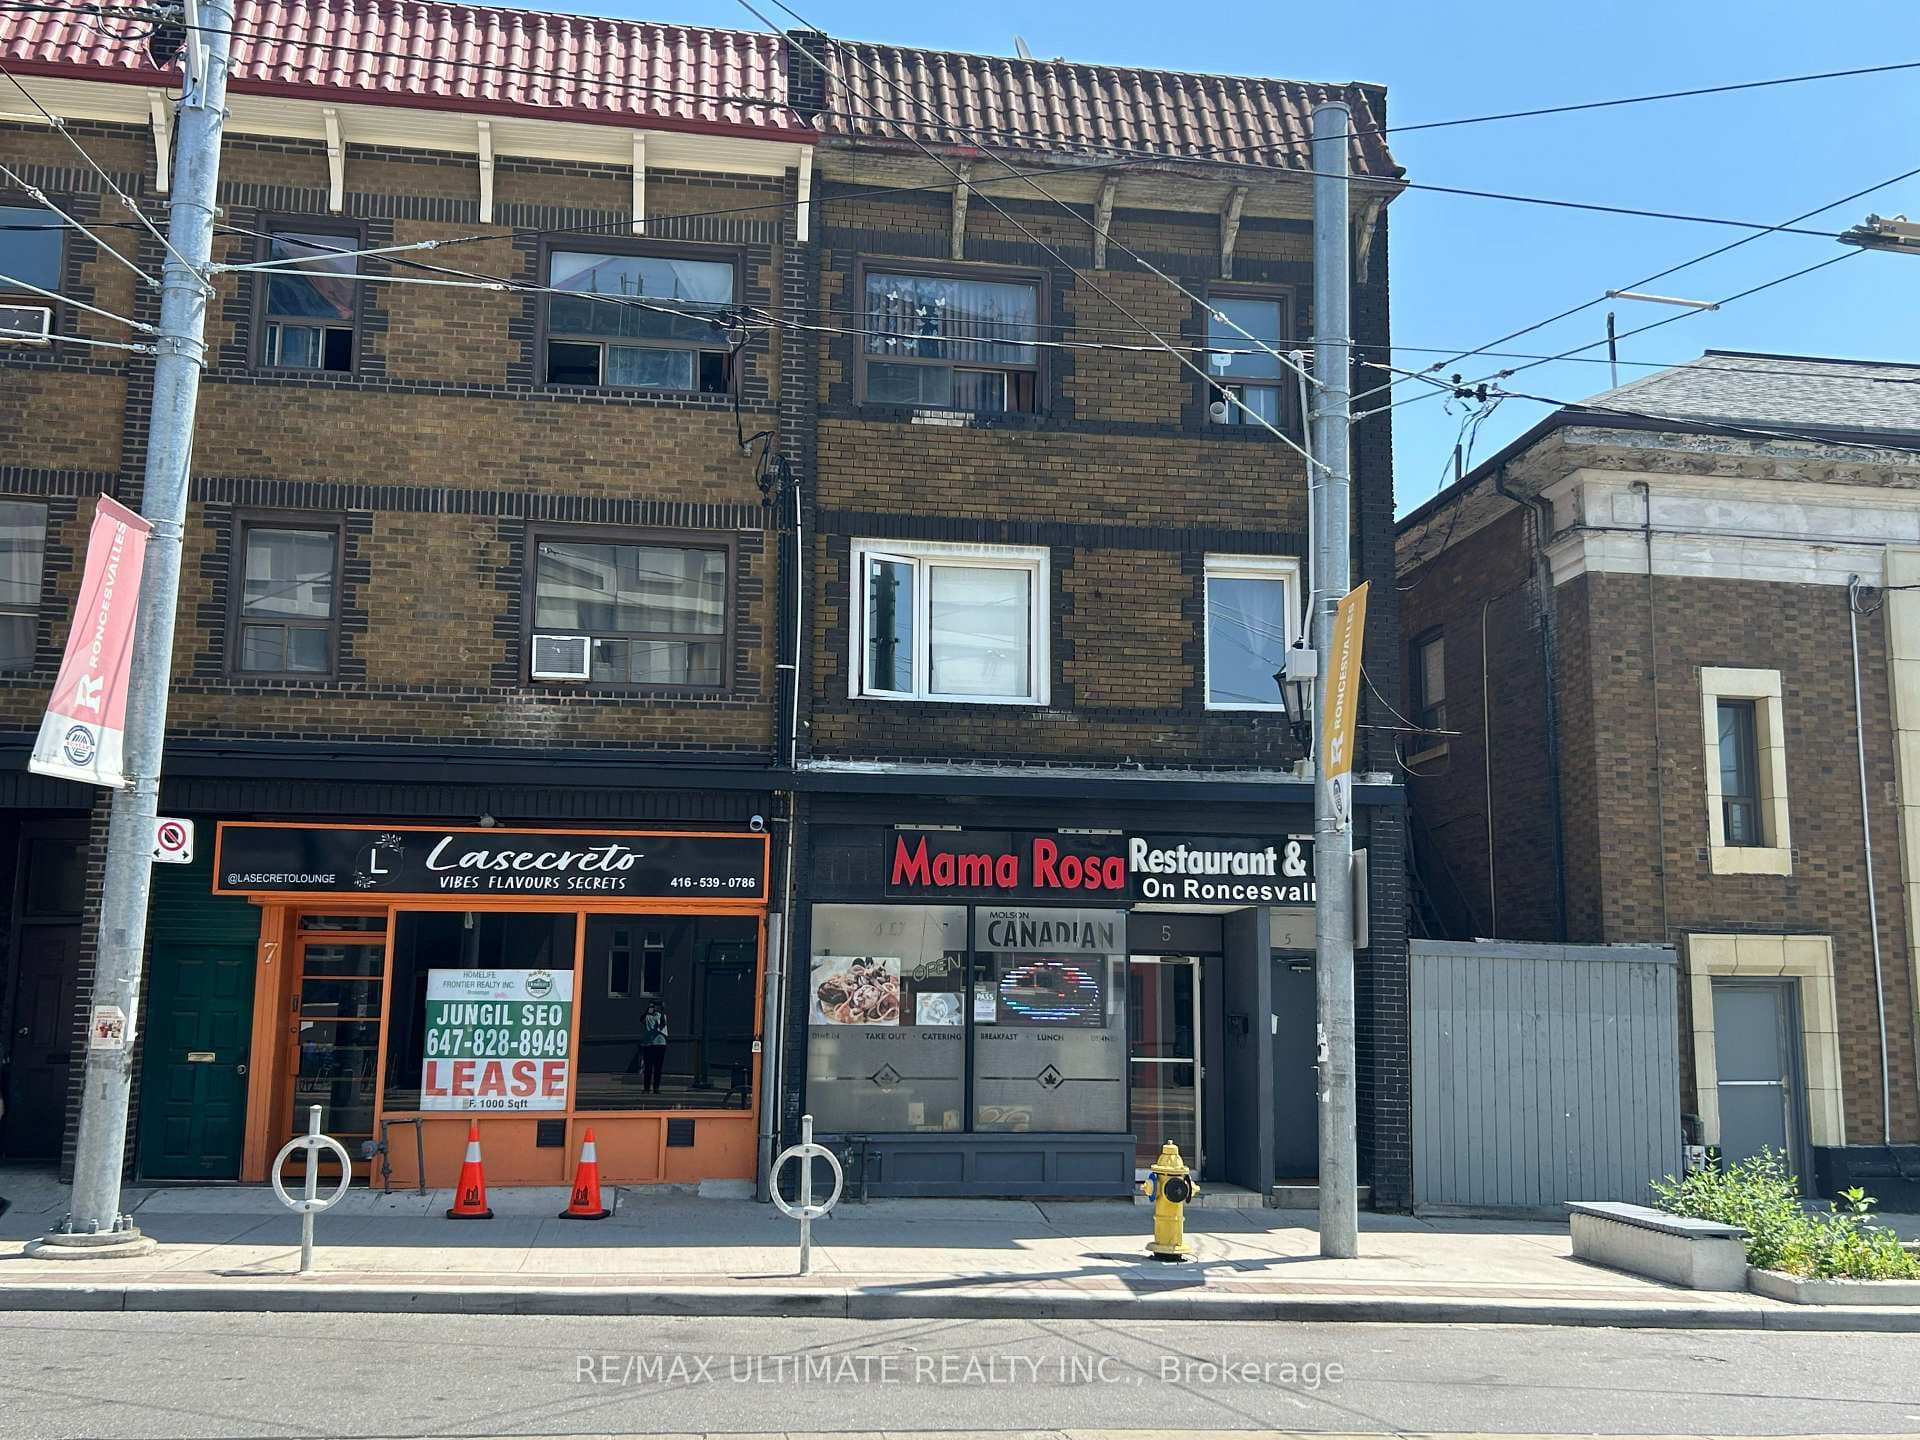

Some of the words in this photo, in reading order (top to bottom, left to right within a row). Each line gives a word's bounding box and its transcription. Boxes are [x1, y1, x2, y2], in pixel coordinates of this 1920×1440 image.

[89, 521, 128, 669] RONCESVALLES
[1335, 602, 1355, 729] RONCESVALLES
[371, 848, 388, 874] L
[425, 836, 645, 872] Lasecreto
[890, 833, 1019, 888] Mama
[1032, 837, 1125, 890] Rosa
[1128, 837, 1277, 876] Restaurant
[1282, 840, 1307, 877] &
[227, 873, 336, 884] @LASECRETOLOUNGE
[439, 875, 480, 889] VIBES
[488, 875, 561, 889] FLAVOURS
[567, 876, 628, 890] SECRETS
[1142, 878, 1175, 898] On
[1183, 879, 1316, 901] Roncesvall
[989, 911, 1030, 919] MOLSON
[987, 920, 1114, 949] CANADIAN
[1161, 925, 1172, 942] 5
[1284, 933, 1292, 945] 5
[263, 942, 280, 964] 7
[912, 951, 961, 982] OPEN
[443, 981, 475, 989] FRONTIER
[476, 981, 501, 989] REALTY
[976, 991, 994, 1000] PASS
[436, 1004, 513, 1026] JUNGIL
[521, 1004, 563, 1026] SEO
[426, 1029, 568, 1056] 647-828-8949
[864, 1032, 885, 1040] TAKE
[888, 1032, 906, 1040] OUT
[921, 1032, 962, 1041] CATERING
[980, 1032, 1018, 1041] BREAKFAST
[1037, 1032, 1064, 1041] LUNCH
[425, 1060, 566, 1097] LEASE
[480, 1099, 504, 1108] 1000
[507, 1099, 528, 1109] Sqft
